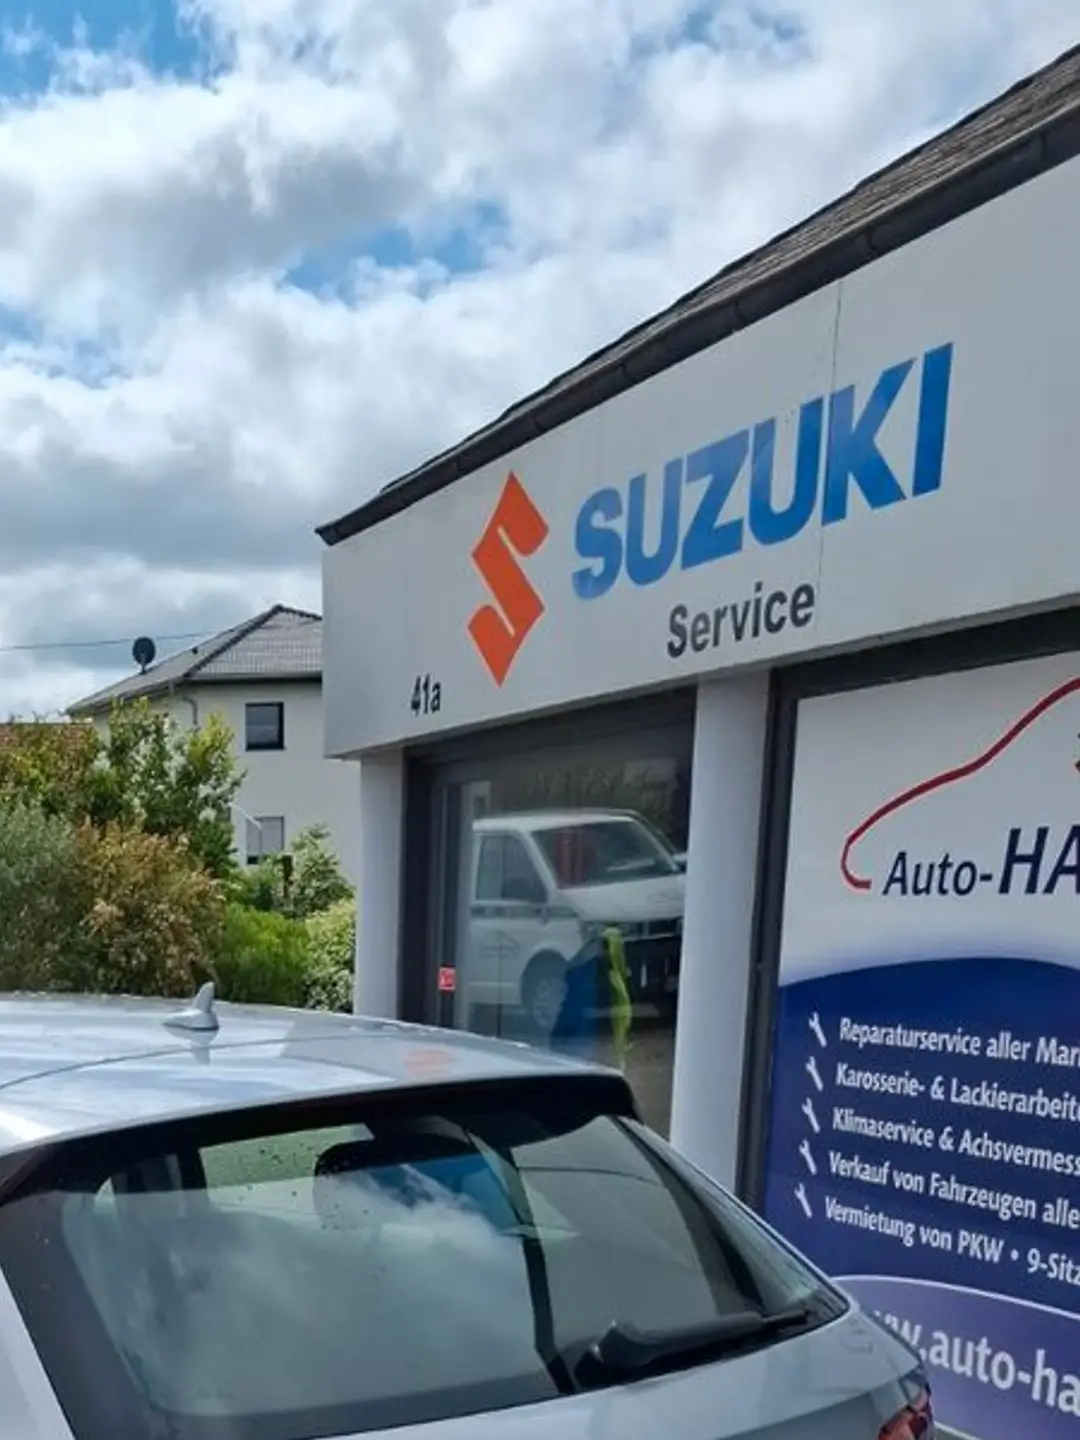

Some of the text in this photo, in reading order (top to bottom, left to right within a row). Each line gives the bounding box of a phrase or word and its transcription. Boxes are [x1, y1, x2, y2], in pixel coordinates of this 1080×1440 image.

[571, 342, 954, 602] SUZUKI
[667, 581, 816, 658] Service
[410, 675, 441, 718] 41a
[839, 1017, 1080, 1069] Reparaturservice aller Mar
[835, 1062, 1080, 1122] Karosserie- & Lackierarbeit
[832, 1106, 934, 1148] Klimaservice
[938, 1125, 956, 1151] &
[829, 1151, 1080, 1230] Verkauf von Fahrzeugen alle
[825, 1195, 916, 1248] Vermietung
[920, 1225, 953, 1251] von
[957, 1230, 1005, 1264] PKW
